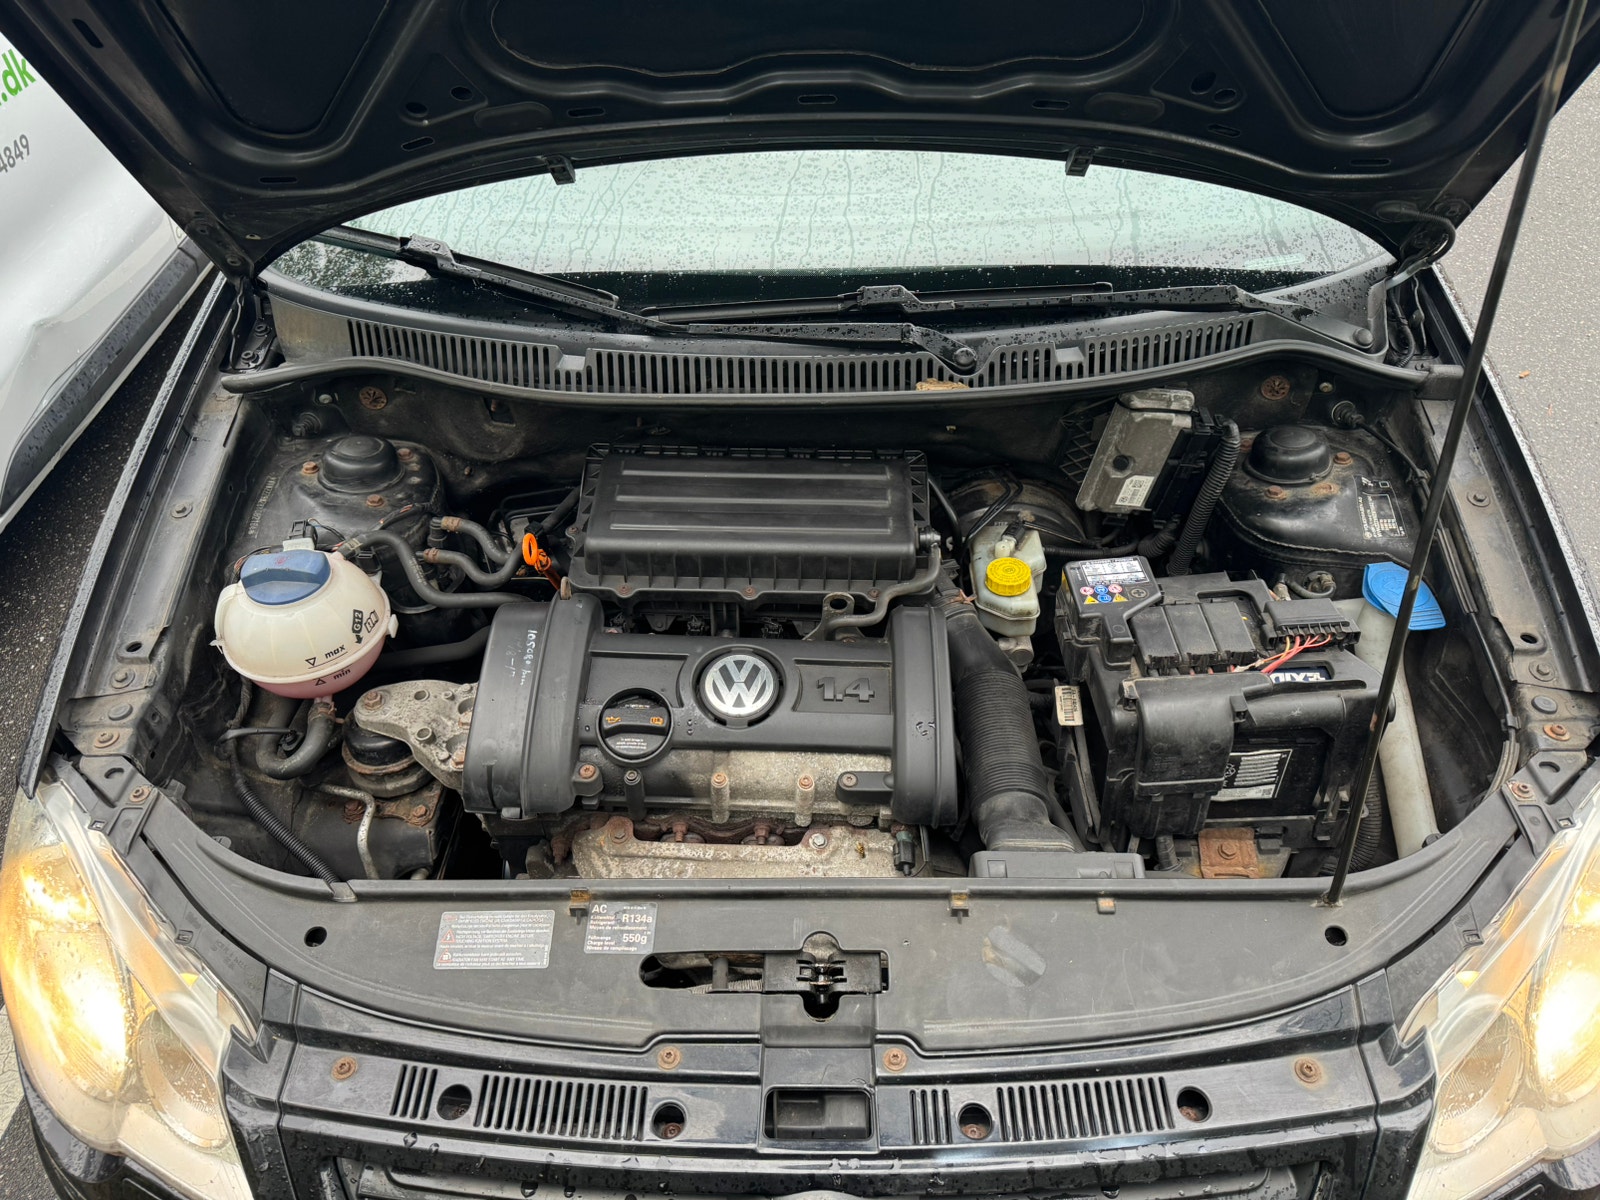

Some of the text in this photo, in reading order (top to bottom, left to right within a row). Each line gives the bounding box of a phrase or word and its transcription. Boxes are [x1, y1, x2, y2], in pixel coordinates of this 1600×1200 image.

[354, 611, 362, 630] G12
[325, 644, 346, 659] max
[333, 668, 351, 680] min
[705, 654, 774, 716] VW
[816, 677, 876, 703] 1.4
[591, 904, 607, 914] AC
[622, 913, 653, 923] R134a
[622, 933, 648, 945] 550g
